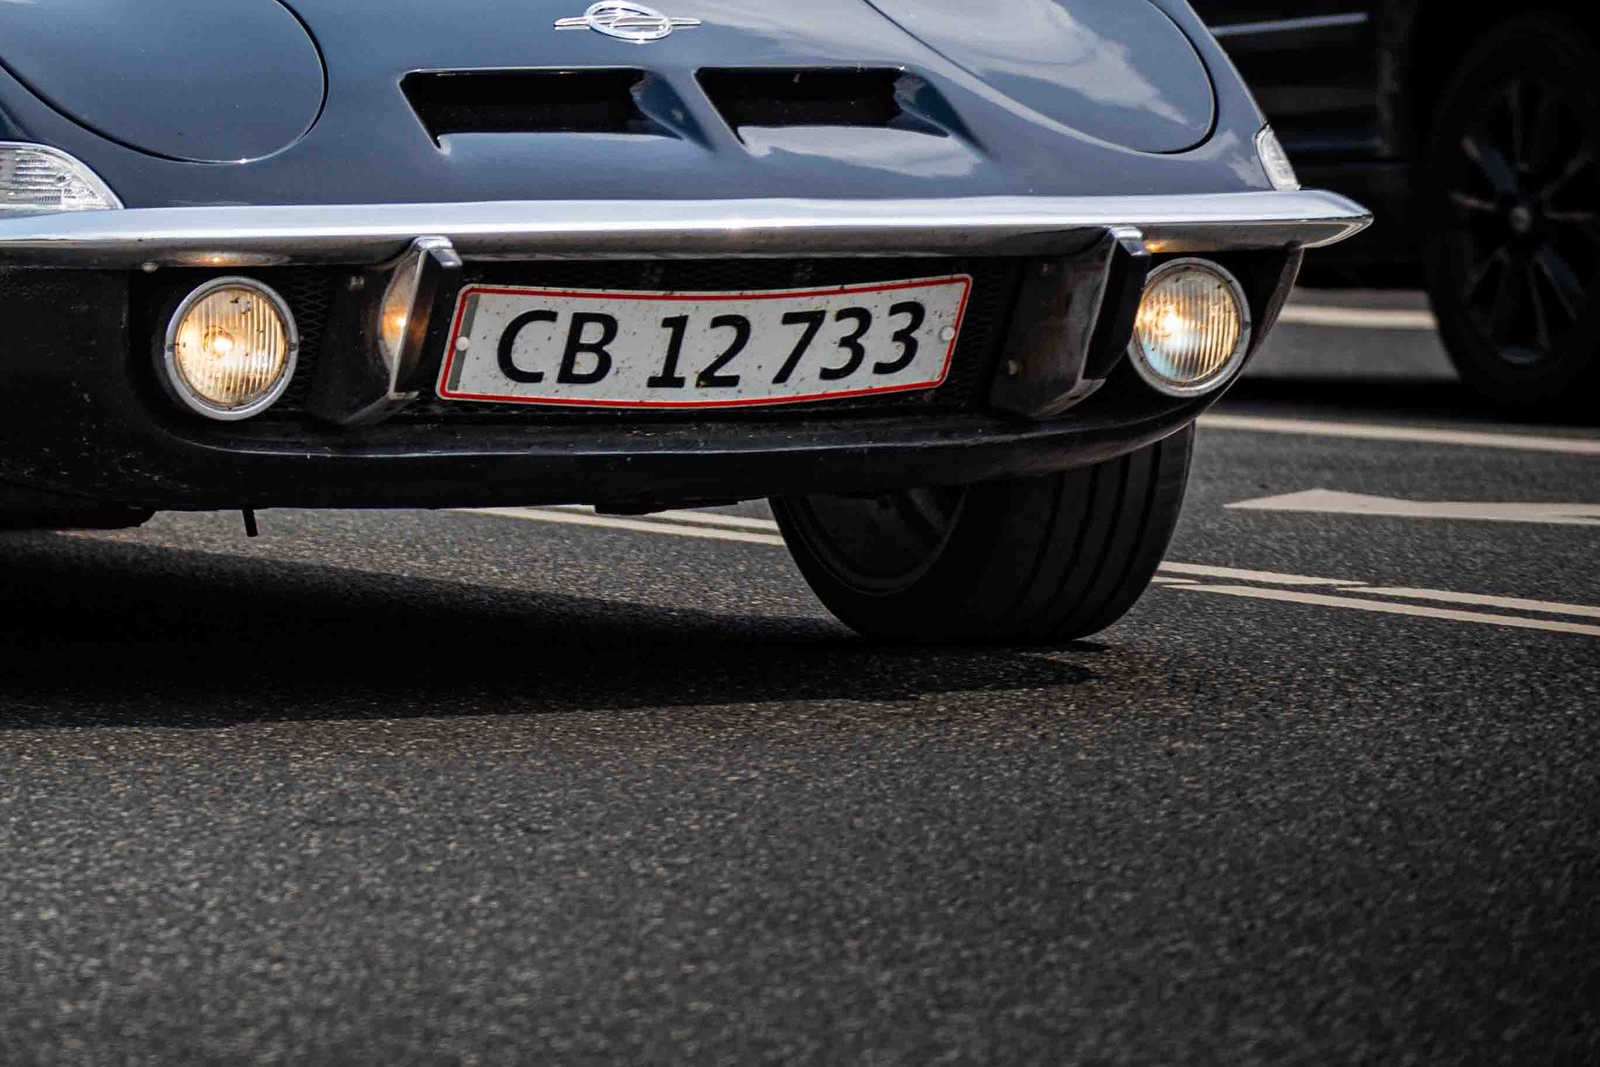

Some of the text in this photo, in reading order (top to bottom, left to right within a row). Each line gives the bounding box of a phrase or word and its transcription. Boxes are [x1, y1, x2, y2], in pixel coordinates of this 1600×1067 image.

[497, 300, 927, 389] CB 12 733
